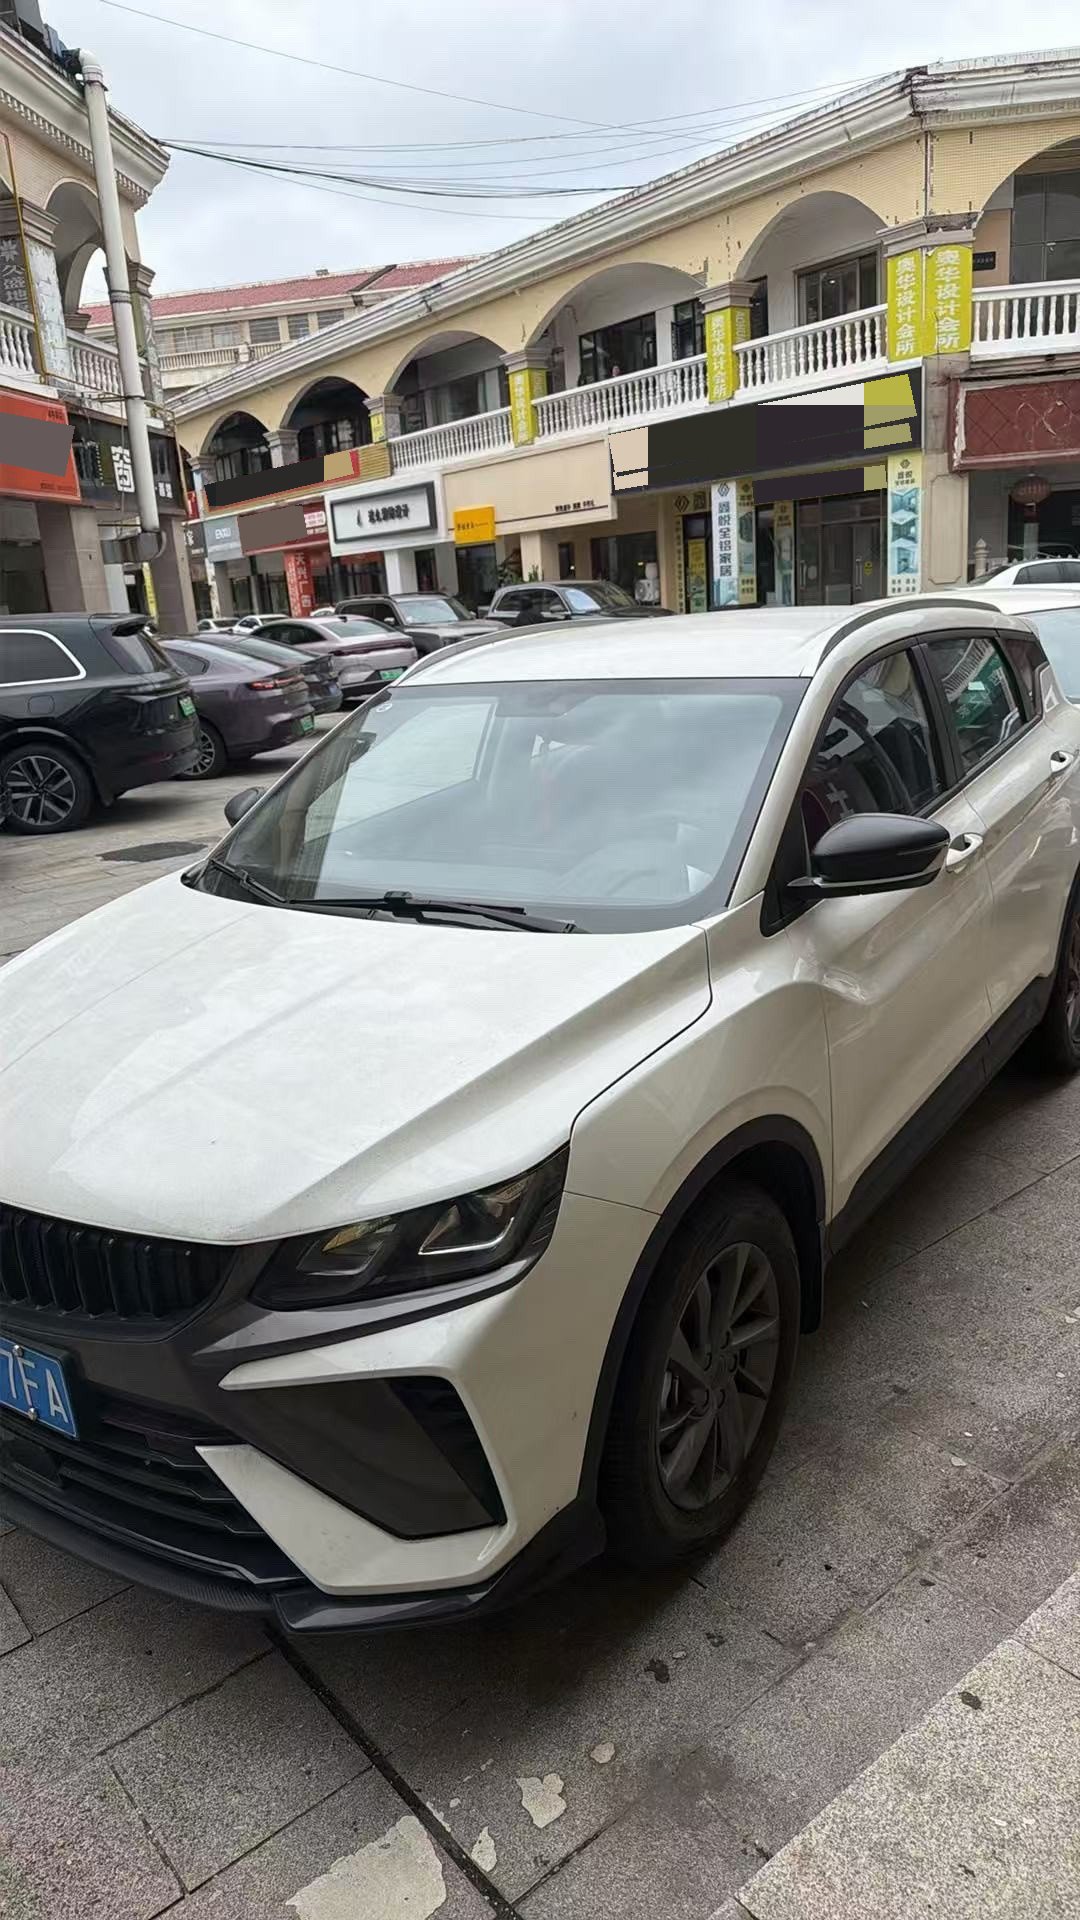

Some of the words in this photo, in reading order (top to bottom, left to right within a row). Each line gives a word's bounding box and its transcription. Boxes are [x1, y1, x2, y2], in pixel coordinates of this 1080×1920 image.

[895, 256, 915, 357] 奥华设计会所
[935, 250, 960, 350] 奥华设计会所
